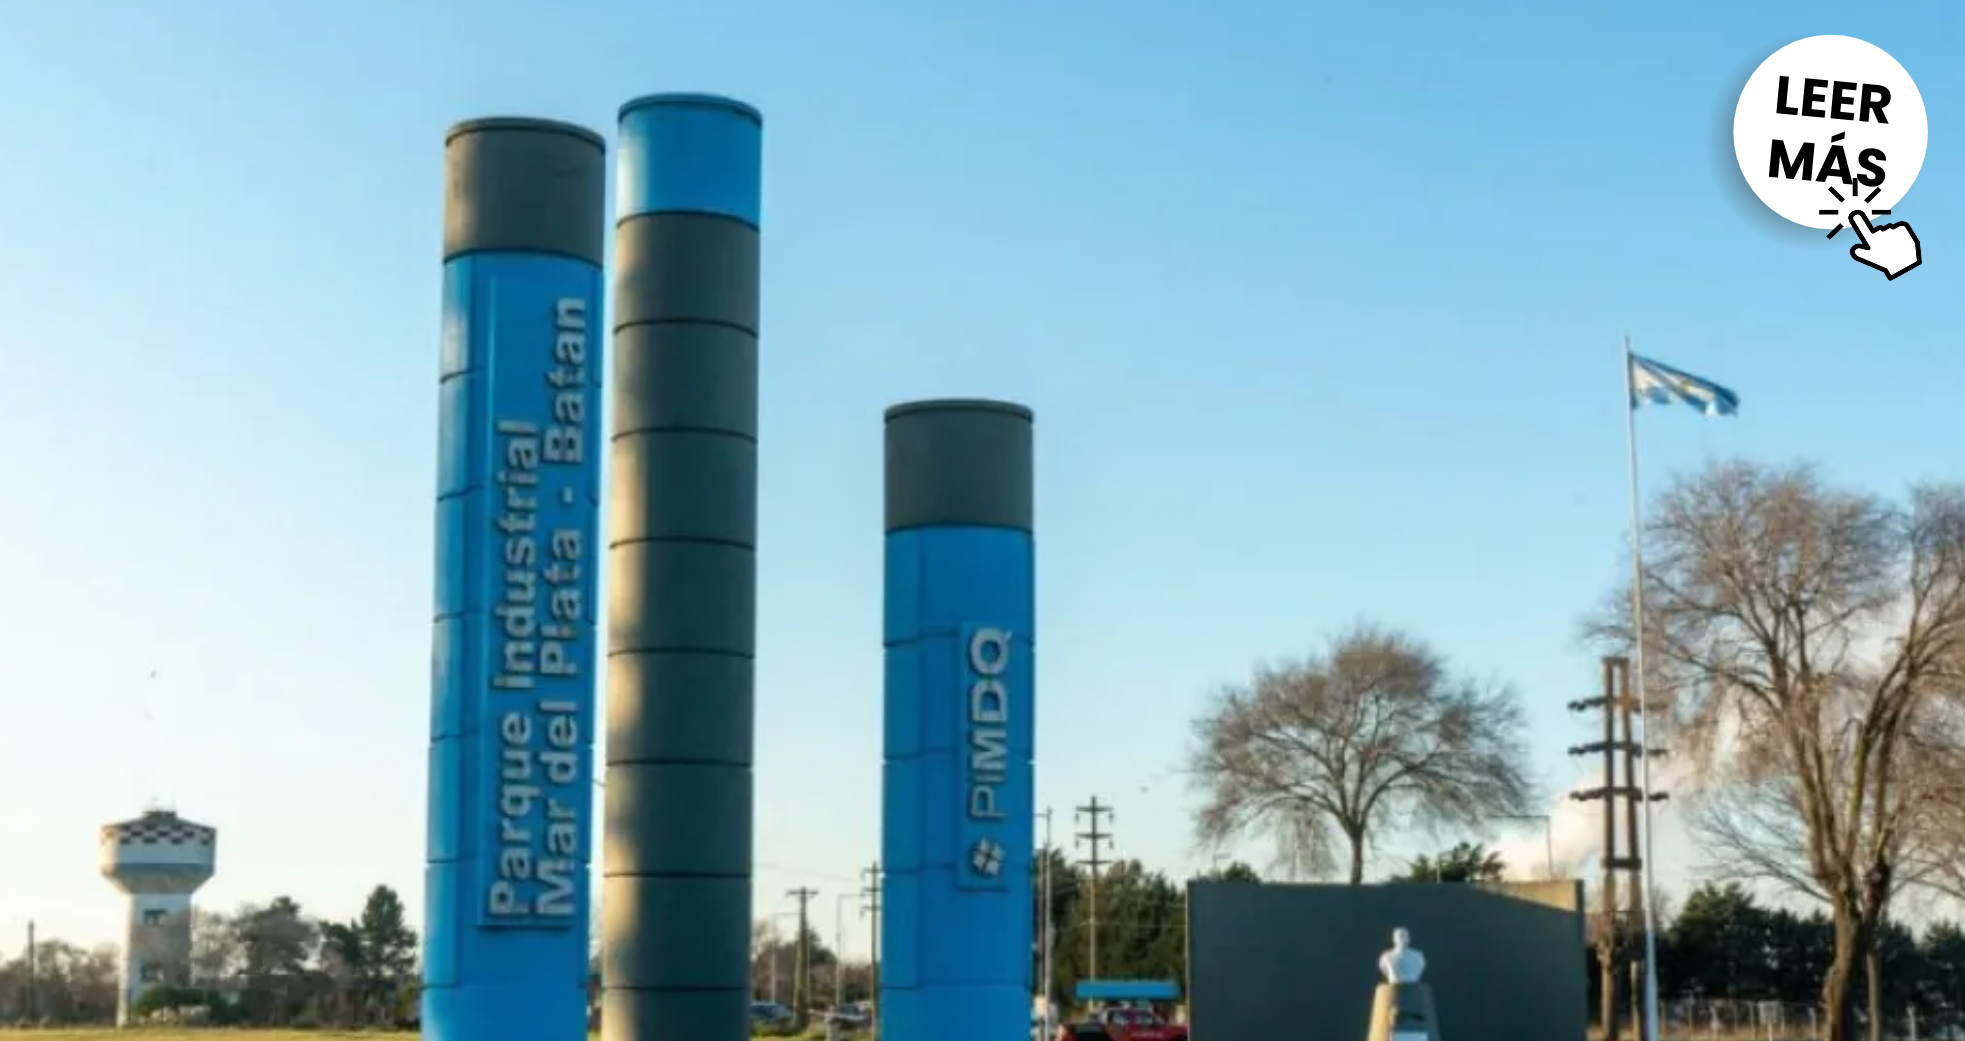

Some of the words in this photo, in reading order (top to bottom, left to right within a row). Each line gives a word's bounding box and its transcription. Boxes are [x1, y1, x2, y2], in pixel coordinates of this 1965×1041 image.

[543, 298, 586, 463] Batan
[493, 420, 540, 689] Industrial
[562, 487, 574, 503] -
[541, 528, 582, 675] Plata
[540, 700, 579, 783] del
[970, 627, 1012, 819] PIMDQ
[489, 711, 541, 914] Parque
[536, 800, 577, 915] Mar
